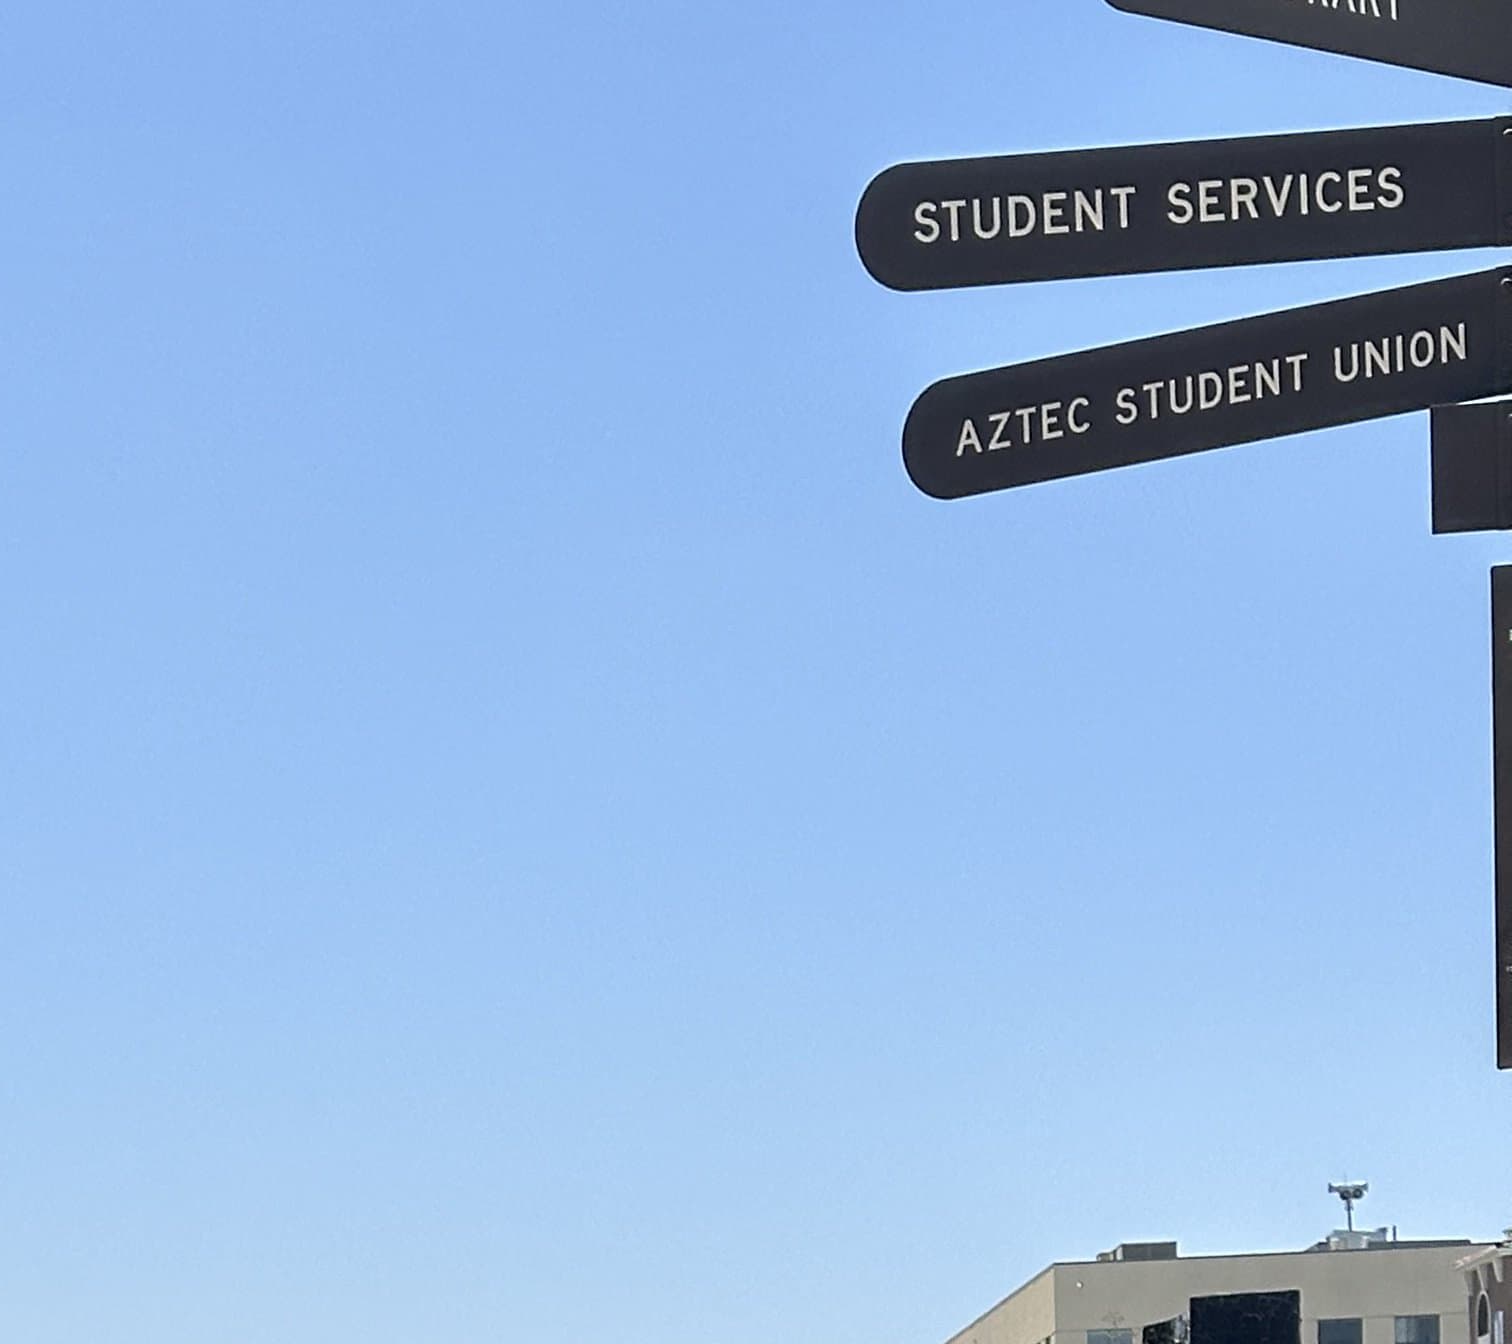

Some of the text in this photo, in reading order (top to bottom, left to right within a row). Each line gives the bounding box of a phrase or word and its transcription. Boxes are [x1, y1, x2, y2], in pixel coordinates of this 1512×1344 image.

[913, 167, 1405, 244] STUDENT SERVICES
[955, 323, 1467, 457] AZTEC STUDENT UNION
